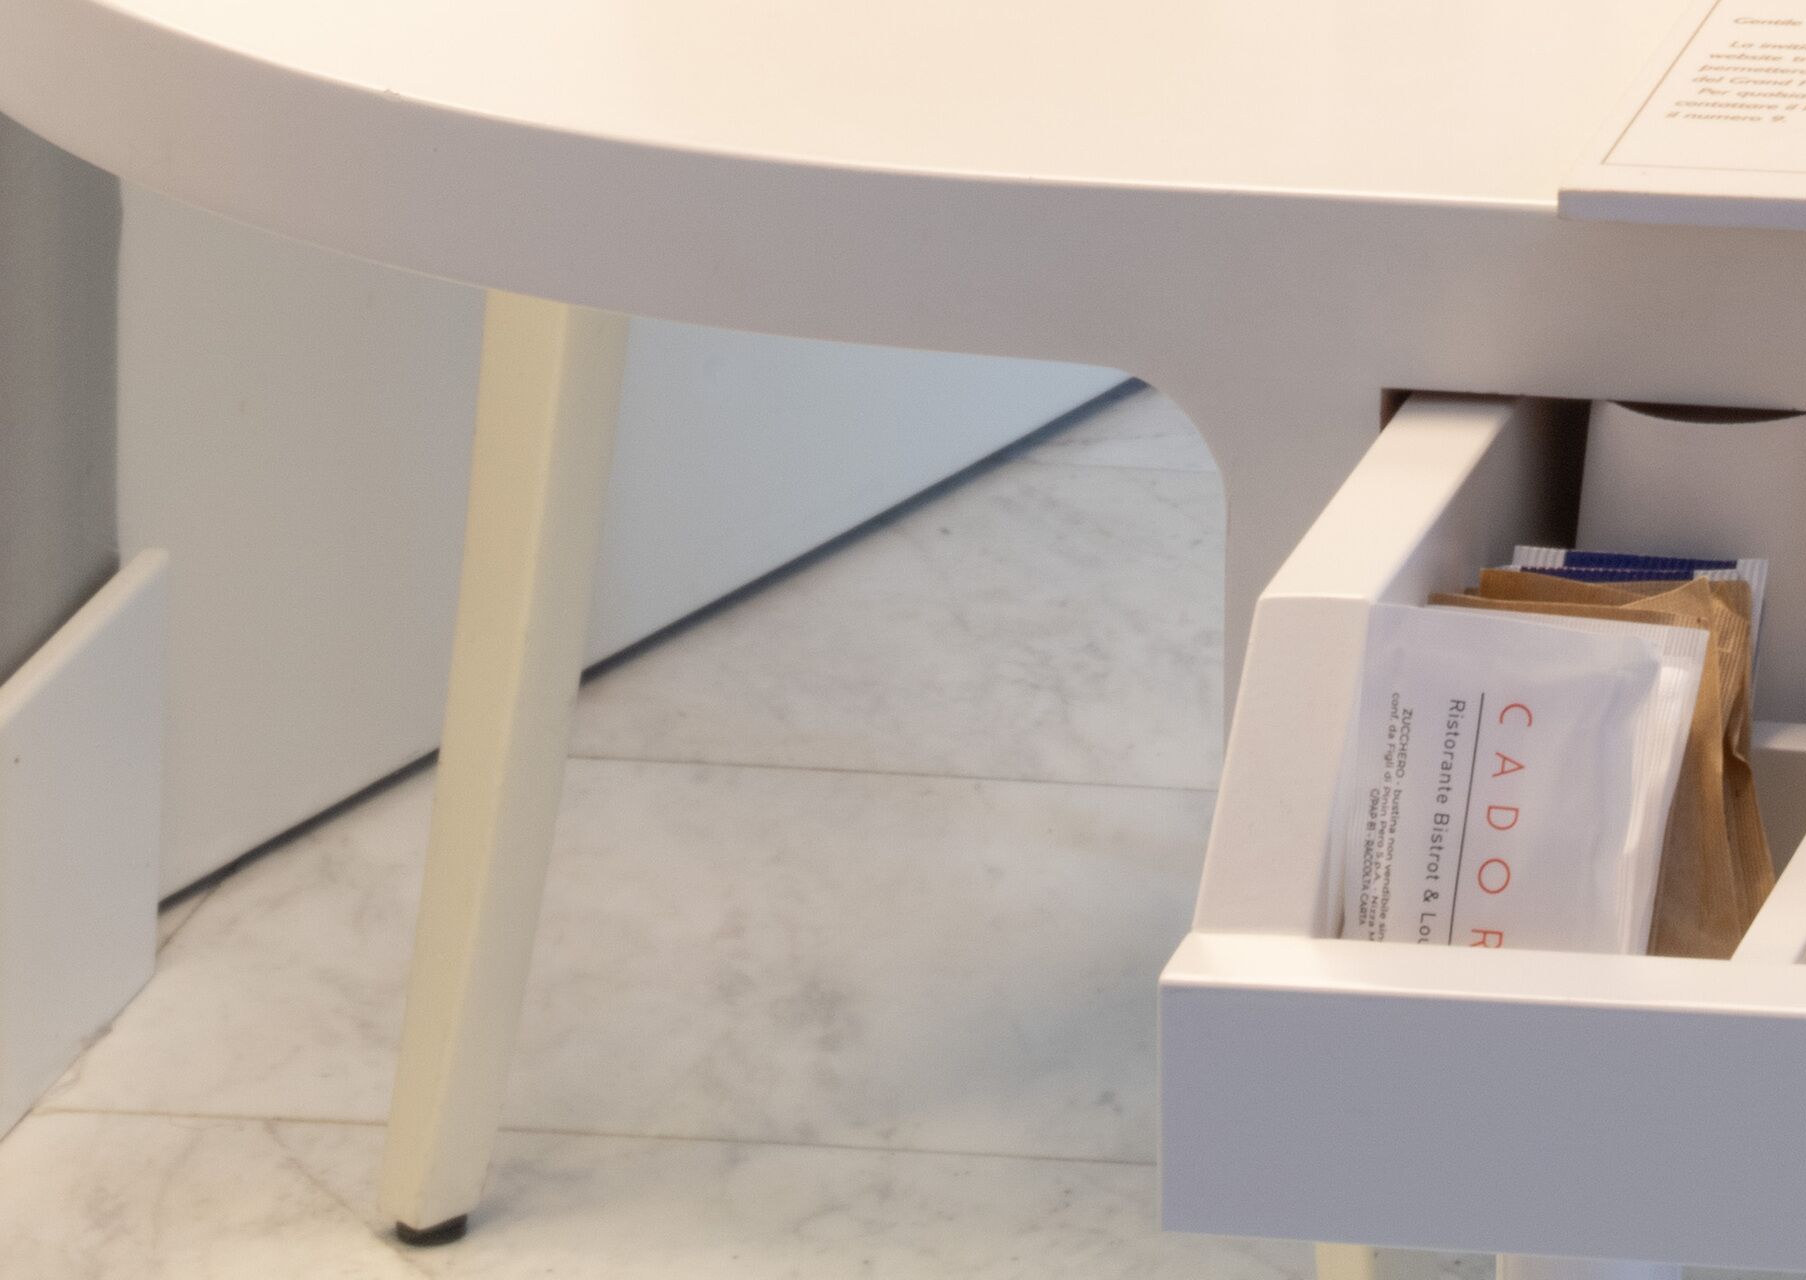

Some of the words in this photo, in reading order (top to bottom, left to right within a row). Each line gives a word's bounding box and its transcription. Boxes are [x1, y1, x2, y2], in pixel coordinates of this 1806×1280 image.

[1733, 16, 1803, 27] Gentile
[1387, 724, 1398, 740] da
[1396, 707, 1414, 779] ZUCCHERO
[1435, 698, 1466, 804] Ristorante
[1388, 788, 1403, 836] bustina
[1385, 836, 1396, 861] non
[1426, 812, 1450, 882] Bistrot
[1379, 863, 1392, 919] vendibile
[1422, 888, 1439, 903] &
